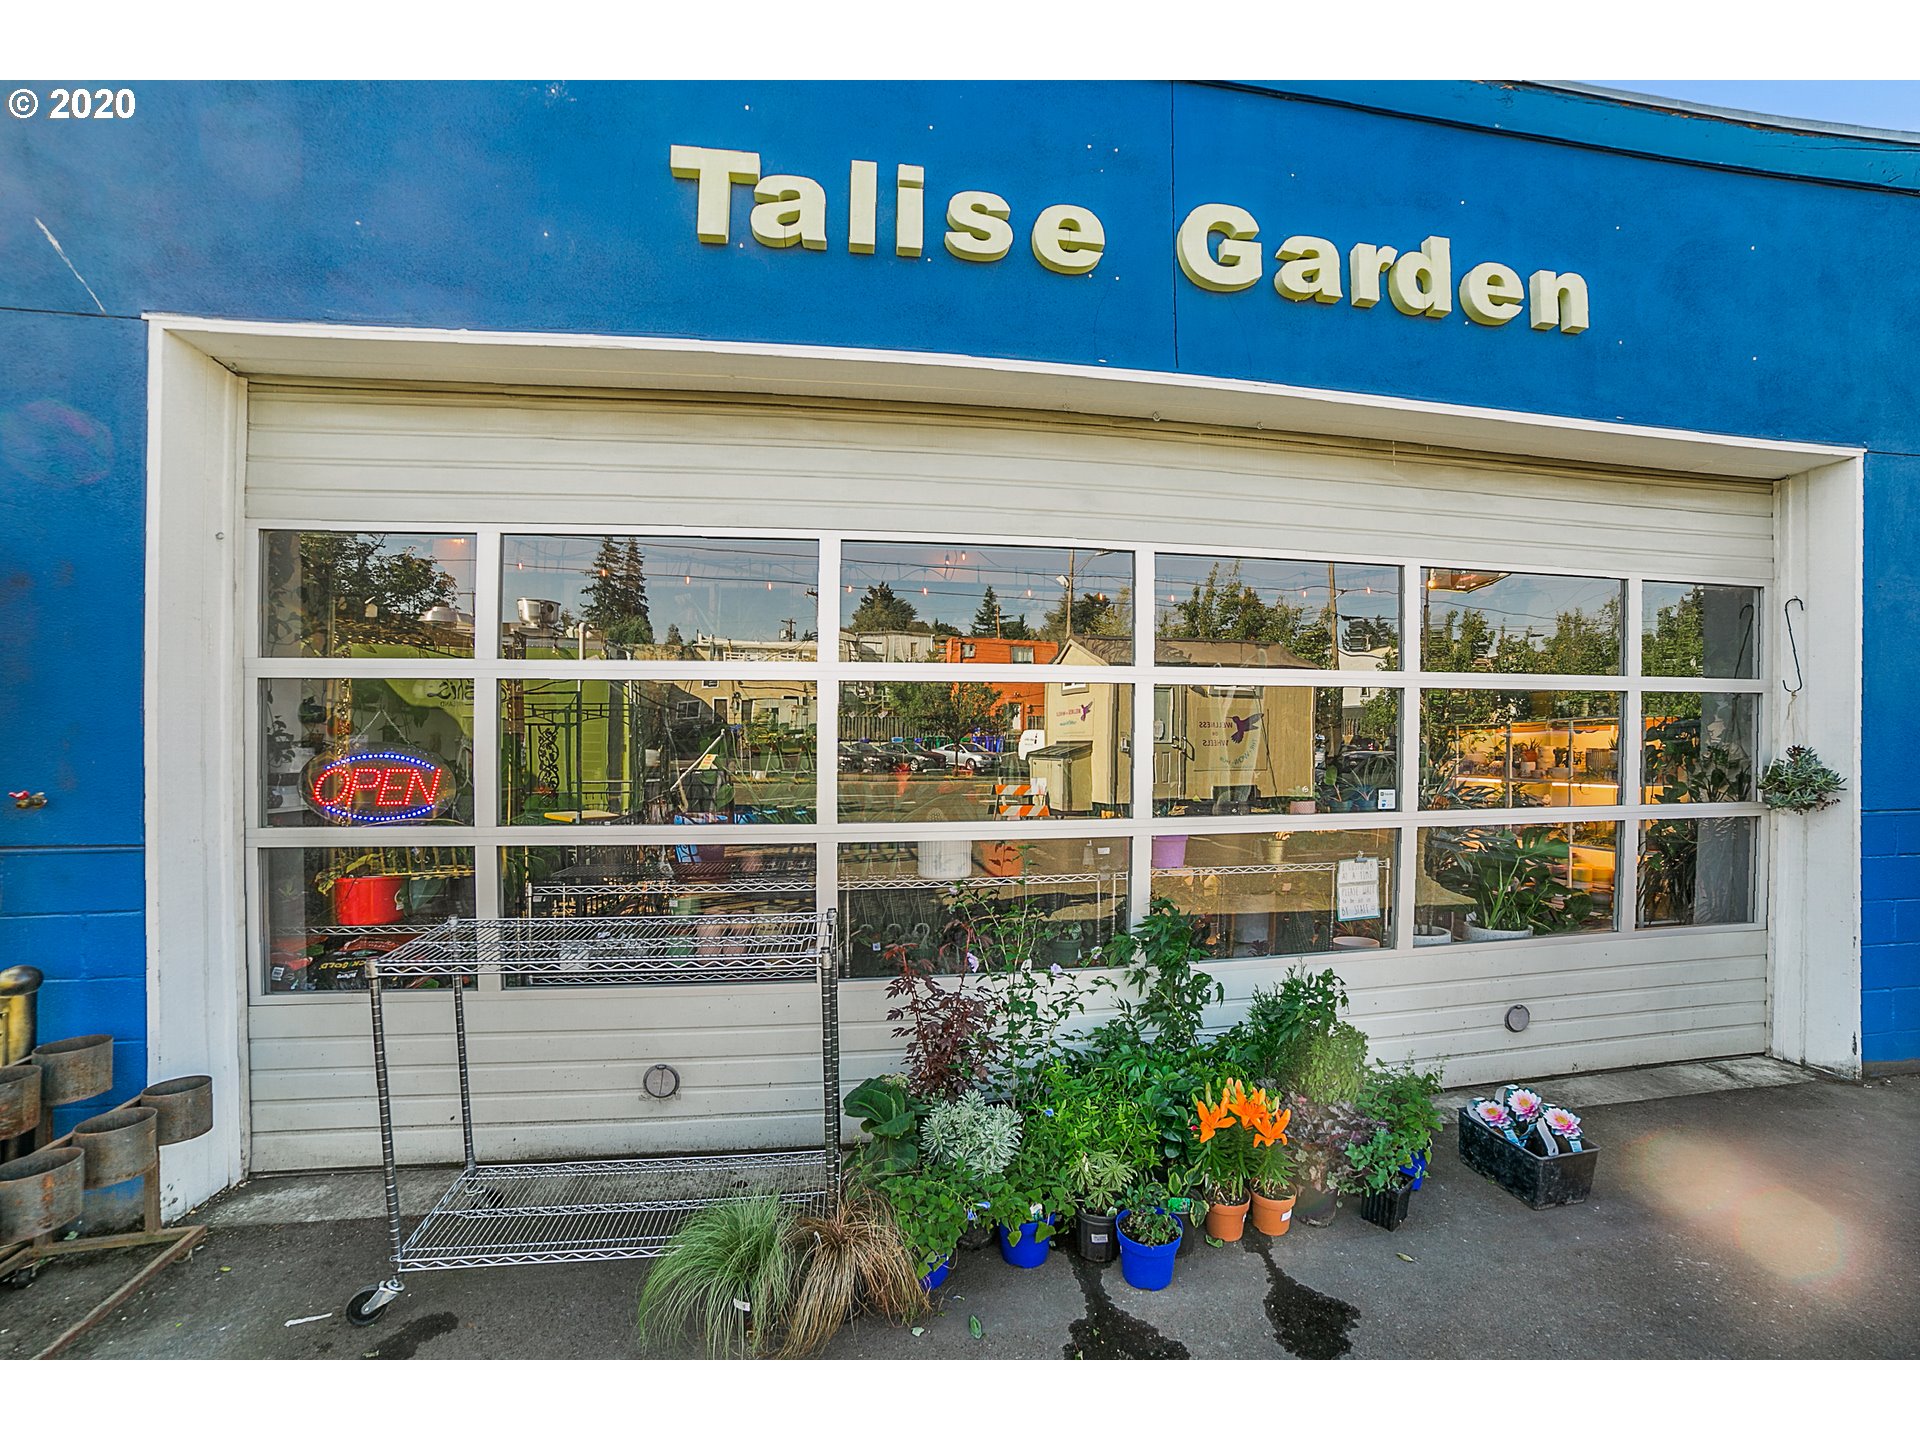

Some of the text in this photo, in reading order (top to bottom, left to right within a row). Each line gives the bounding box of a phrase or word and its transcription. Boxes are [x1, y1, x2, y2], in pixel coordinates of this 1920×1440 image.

[670, 144, 1590, 334] Talise Garden
[313, 767, 442, 806] OPEN
[320, 961, 349, 970] GOLD
